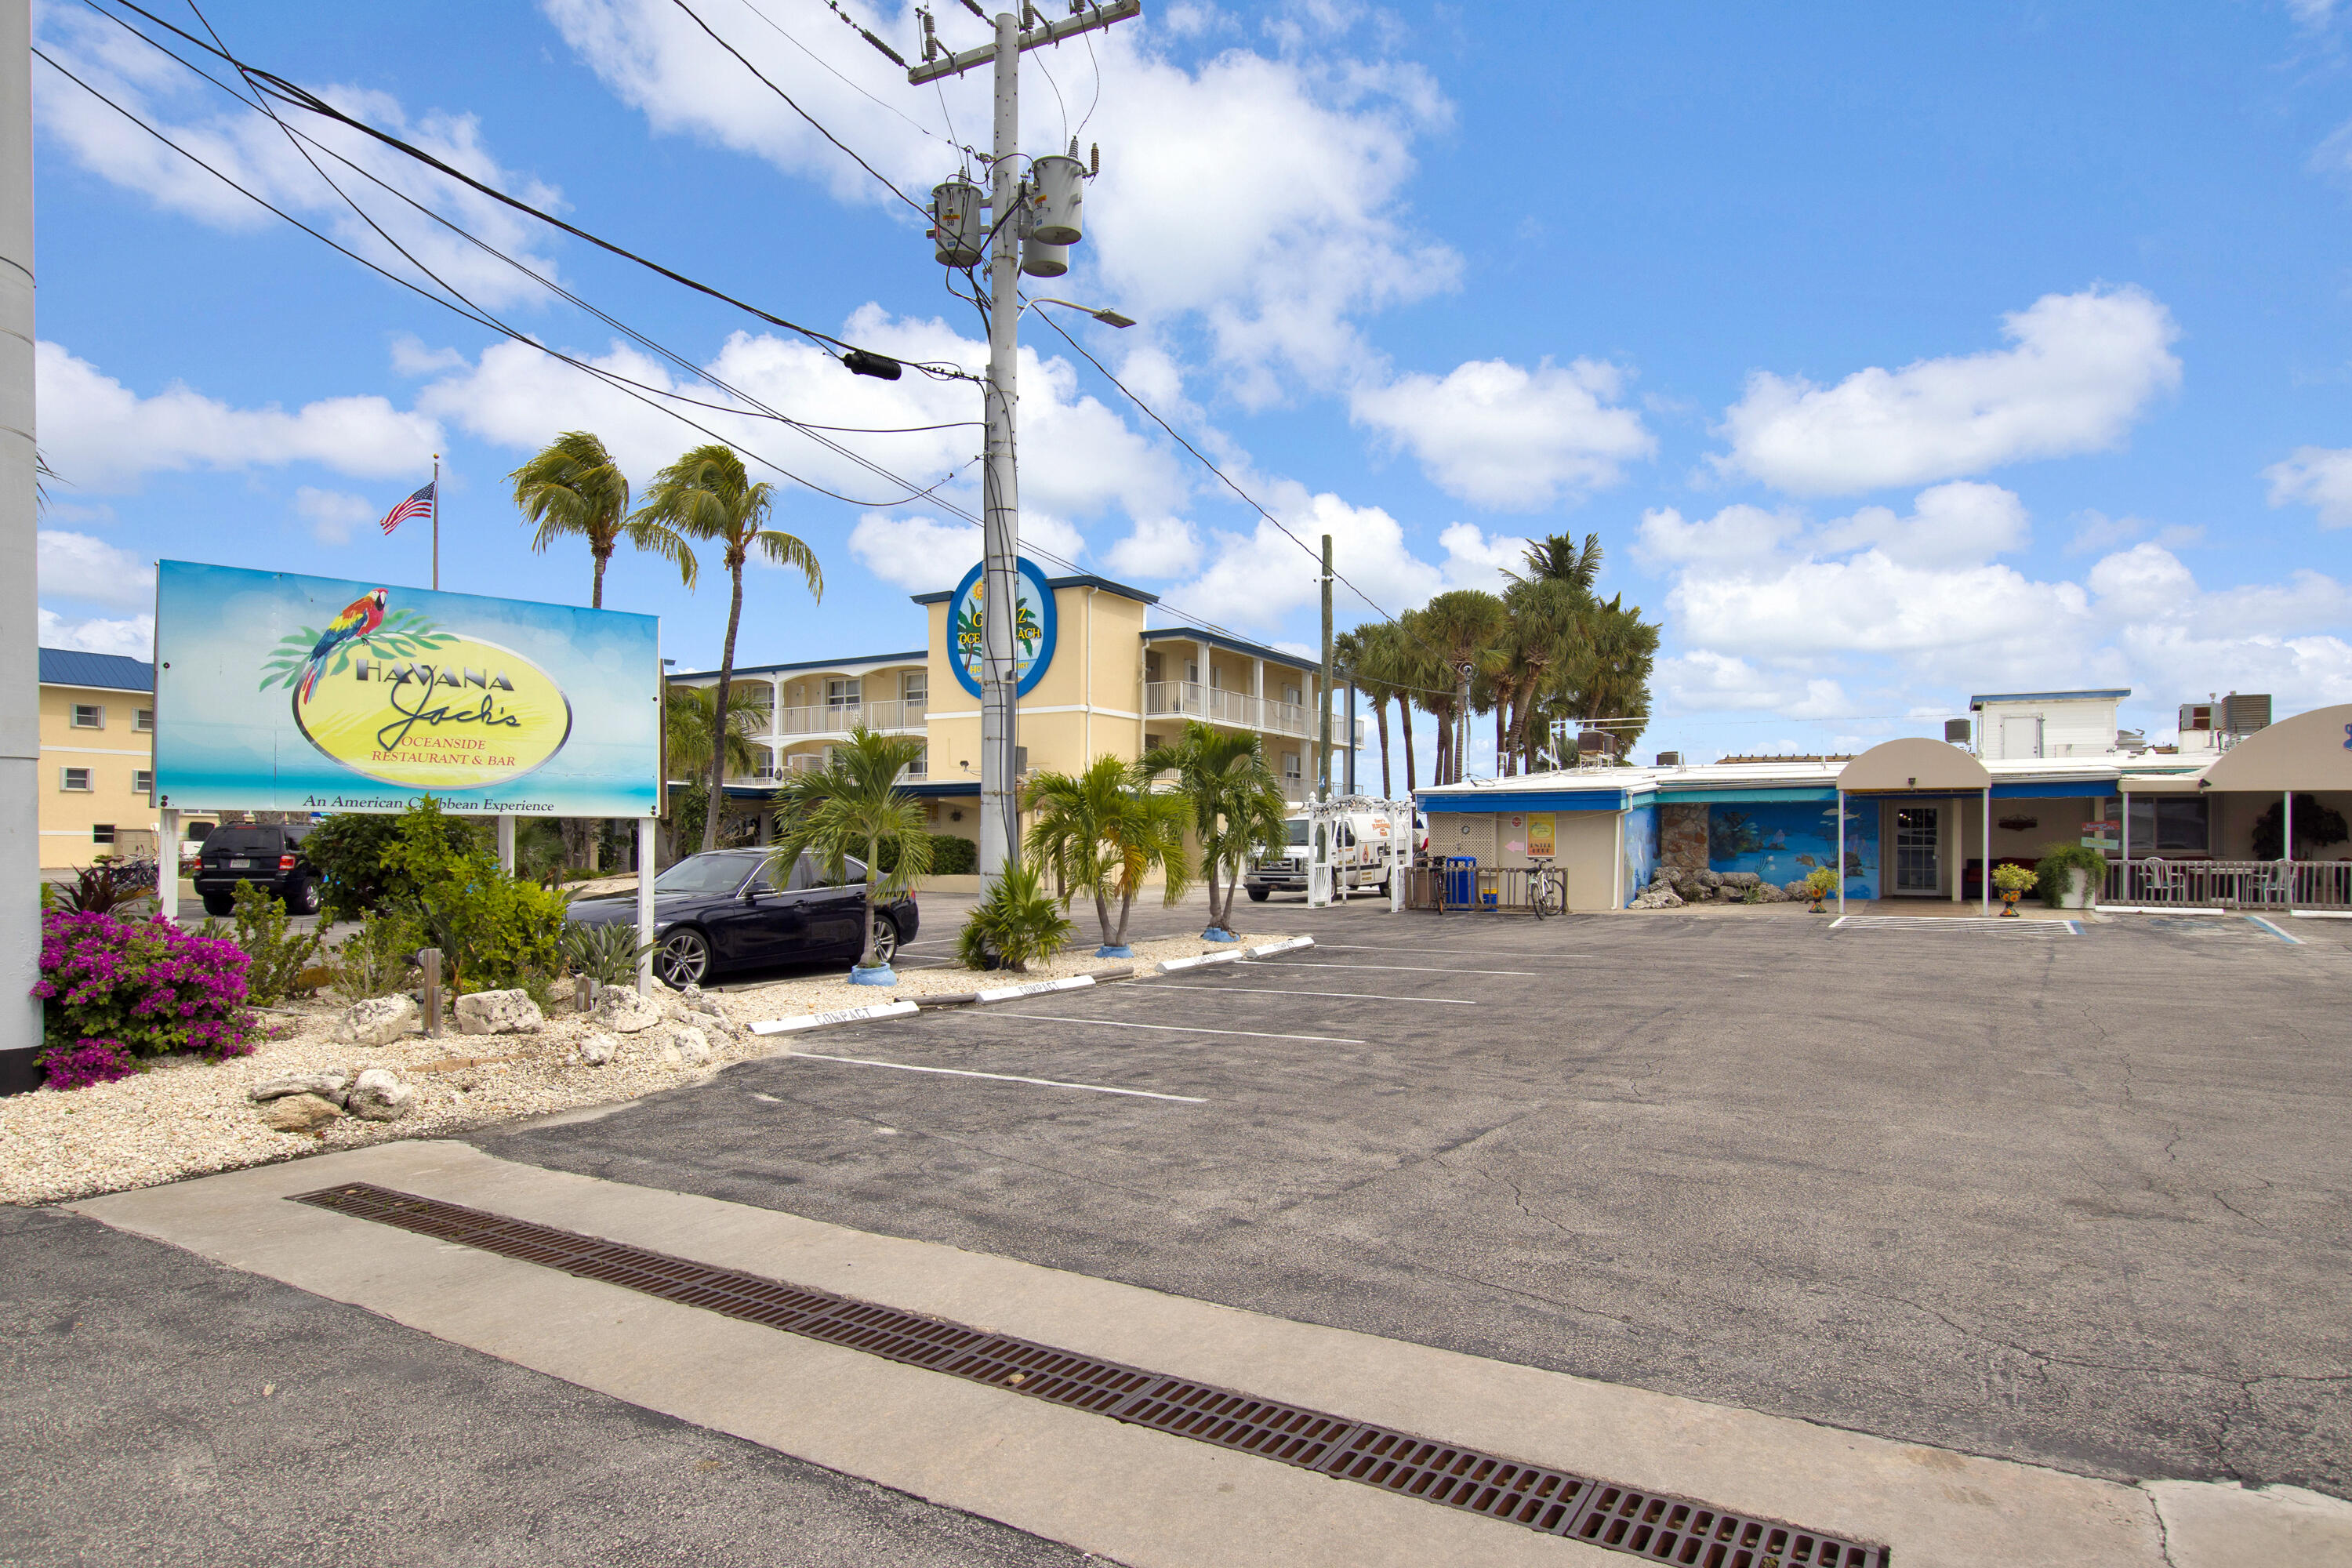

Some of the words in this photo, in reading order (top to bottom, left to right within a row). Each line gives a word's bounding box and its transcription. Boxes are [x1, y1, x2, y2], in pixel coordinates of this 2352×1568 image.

[960, 633, 982, 644] OCE
[356, 659, 514, 691] HAVANA
[377, 664, 521, 751] Jack's
[401, 736, 487, 750] OCEANSIDE
[372, 751, 469, 765] RESTAURANT
[472, 755, 483, 765] &
[488, 756, 516, 766] BAR
[302, 794, 326, 807] An
[331, 796, 403, 808] American
[408, 797, 478, 810] Cabbean
[483, 799, 554, 812] Experience
[1018, 982, 1061, 996] COMPACT
[814, 1007, 873, 1025] COMPACT
